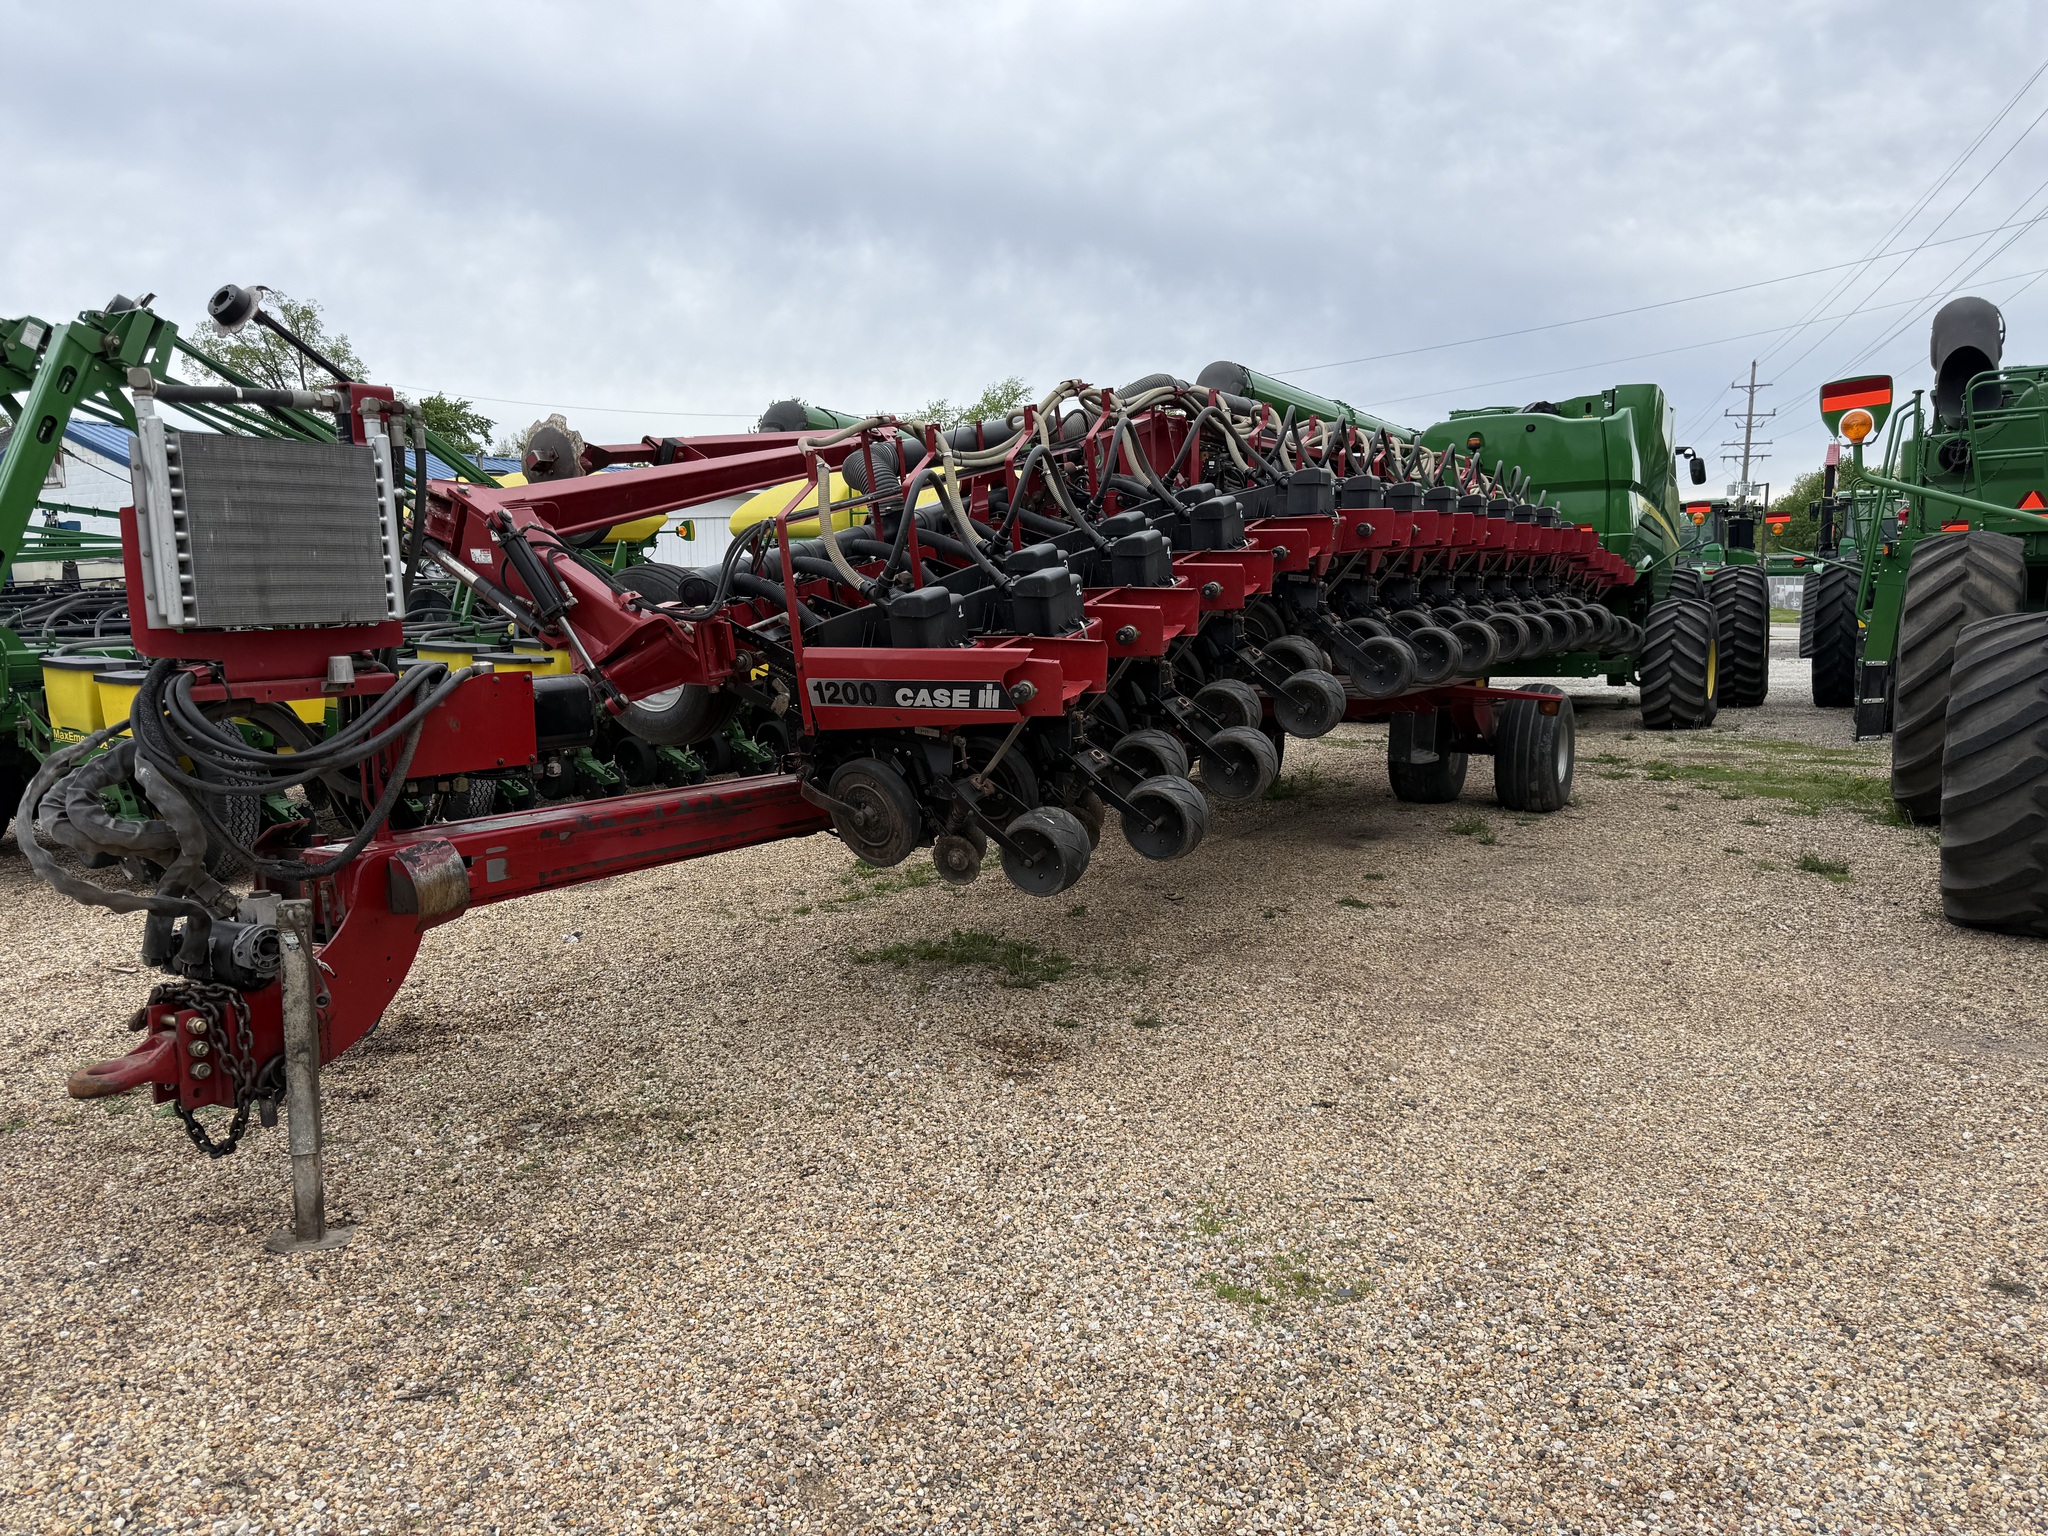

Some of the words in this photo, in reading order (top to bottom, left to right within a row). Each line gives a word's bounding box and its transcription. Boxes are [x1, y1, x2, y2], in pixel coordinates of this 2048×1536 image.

[1075, 583, 1082, 596] 2
[958, 604, 965, 618] 1
[812, 680, 878, 706] 1200
[894, 687, 971, 708] CASE
